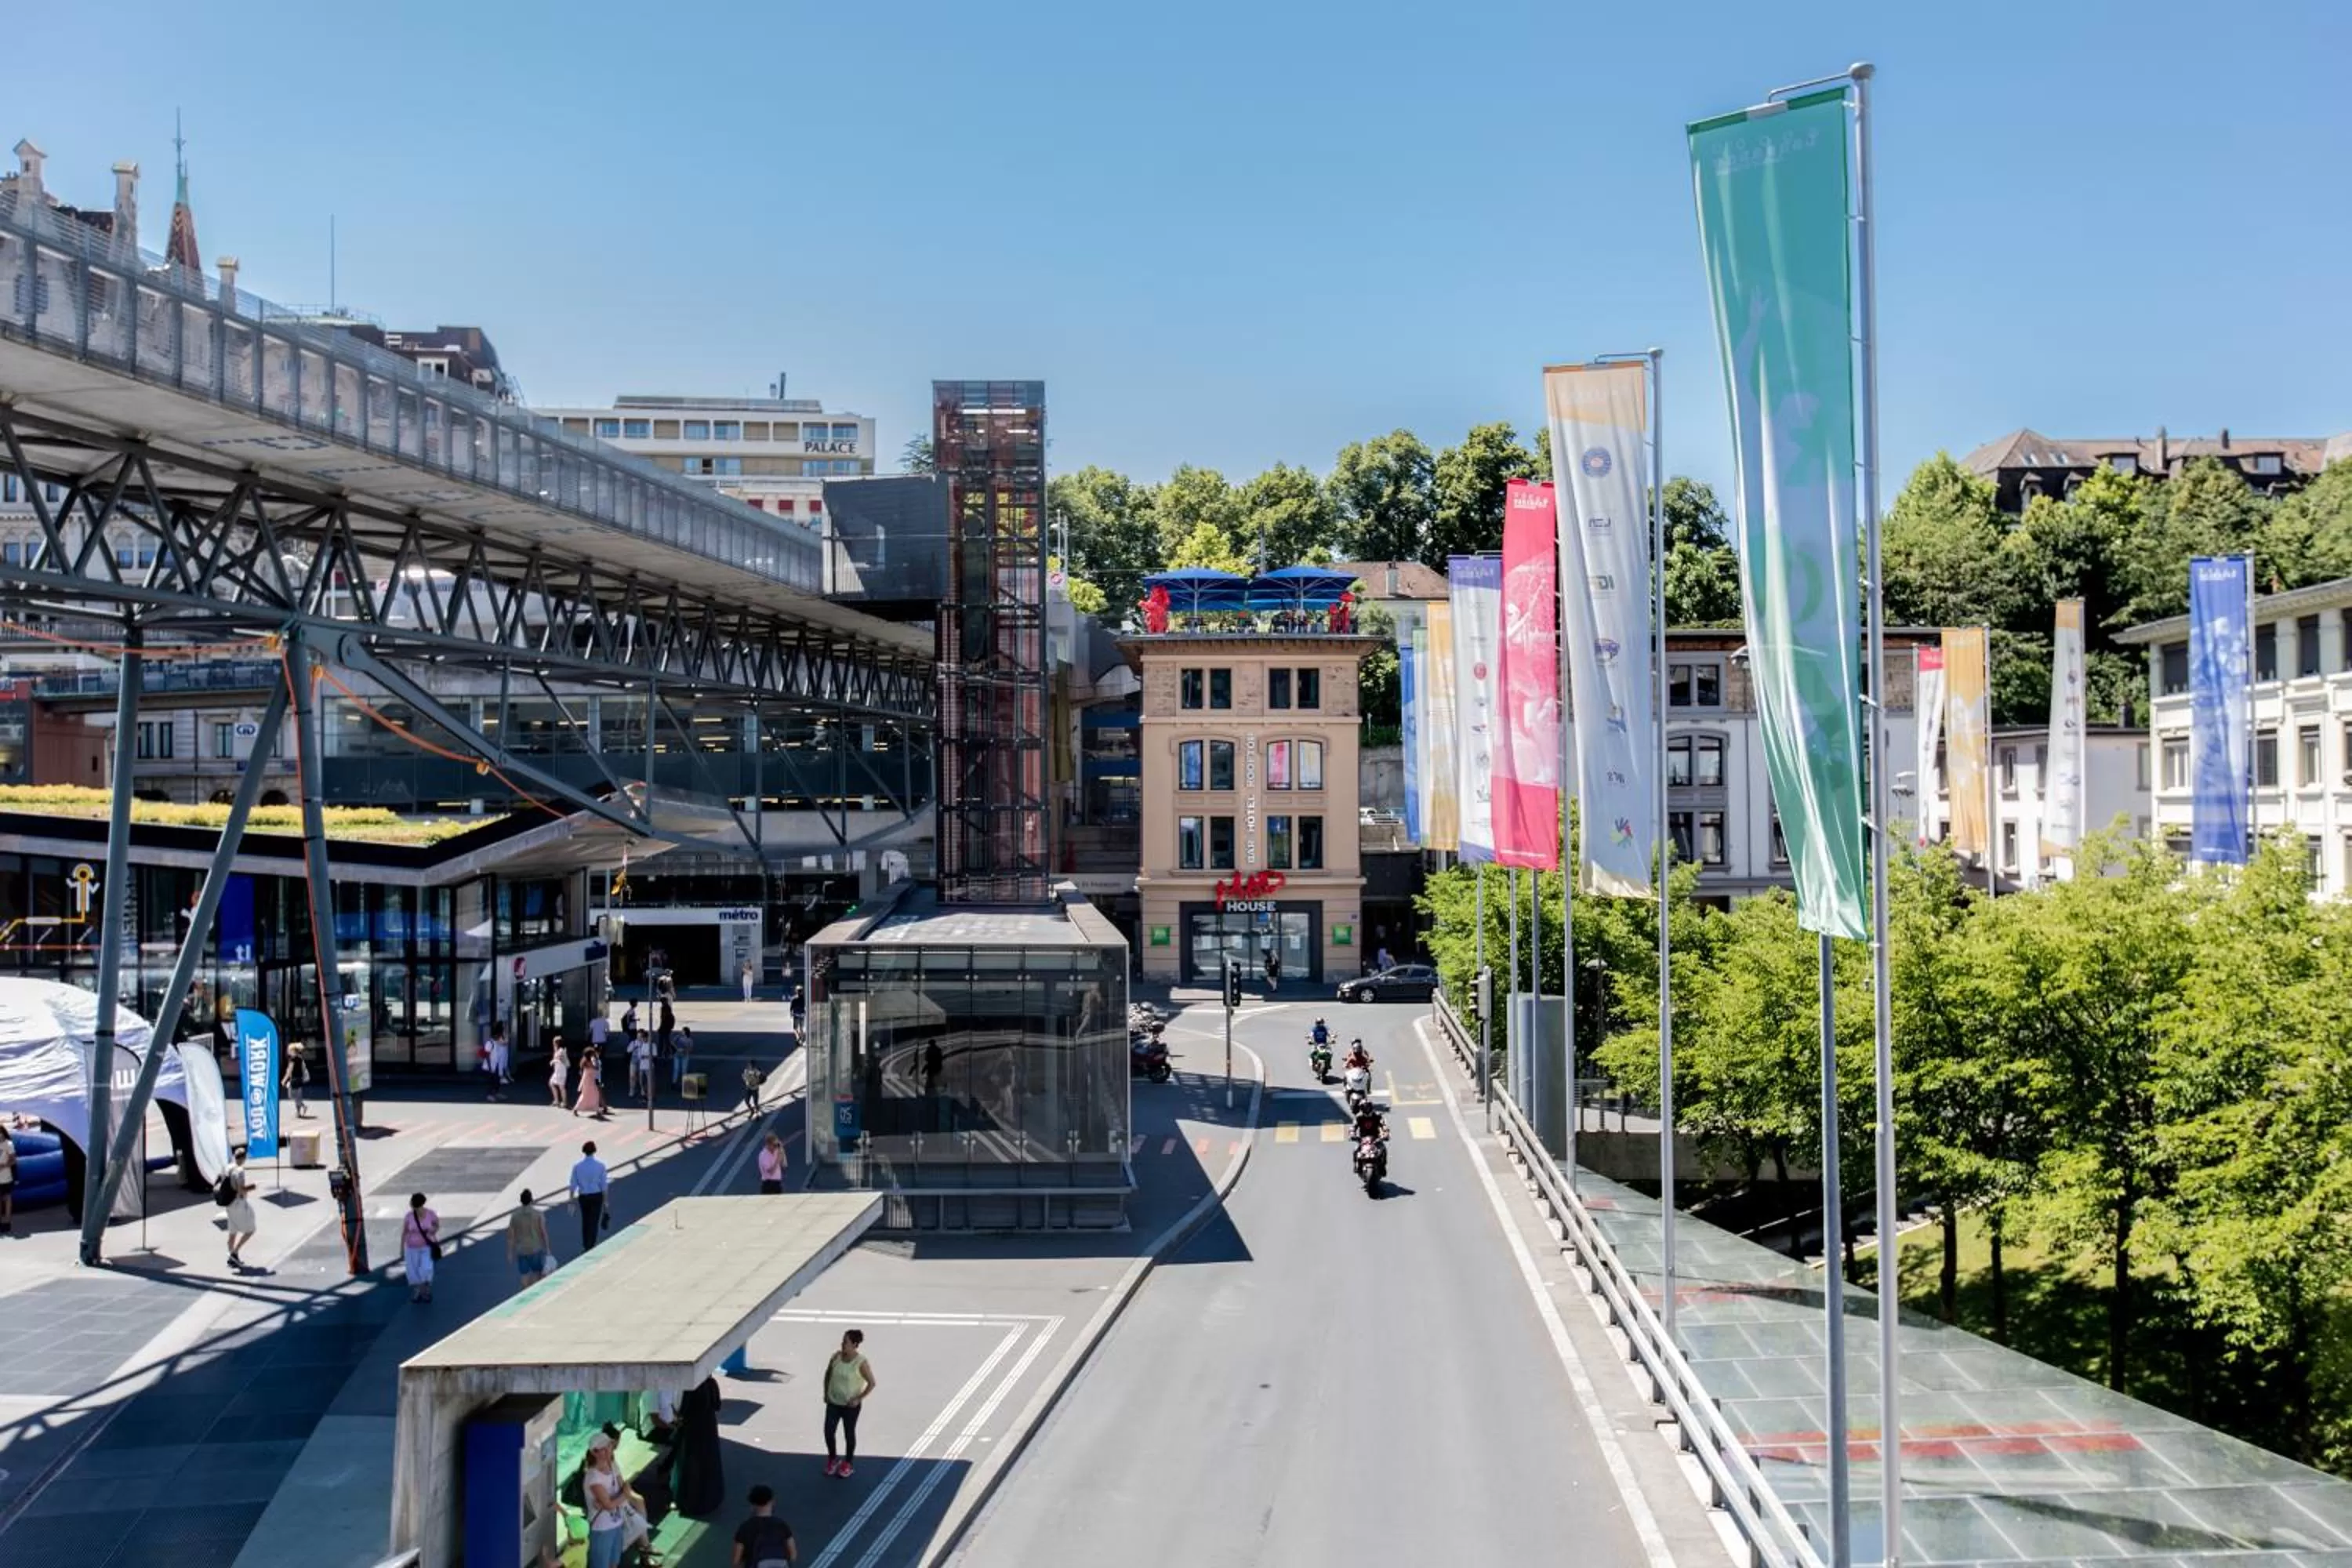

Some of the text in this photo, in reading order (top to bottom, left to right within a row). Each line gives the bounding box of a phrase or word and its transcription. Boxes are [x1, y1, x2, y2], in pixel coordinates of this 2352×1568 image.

[804, 441, 856, 453] PALACE
[1247, 840, 1255, 863] BAR
[1226, 901, 1276, 912] HOUSE
